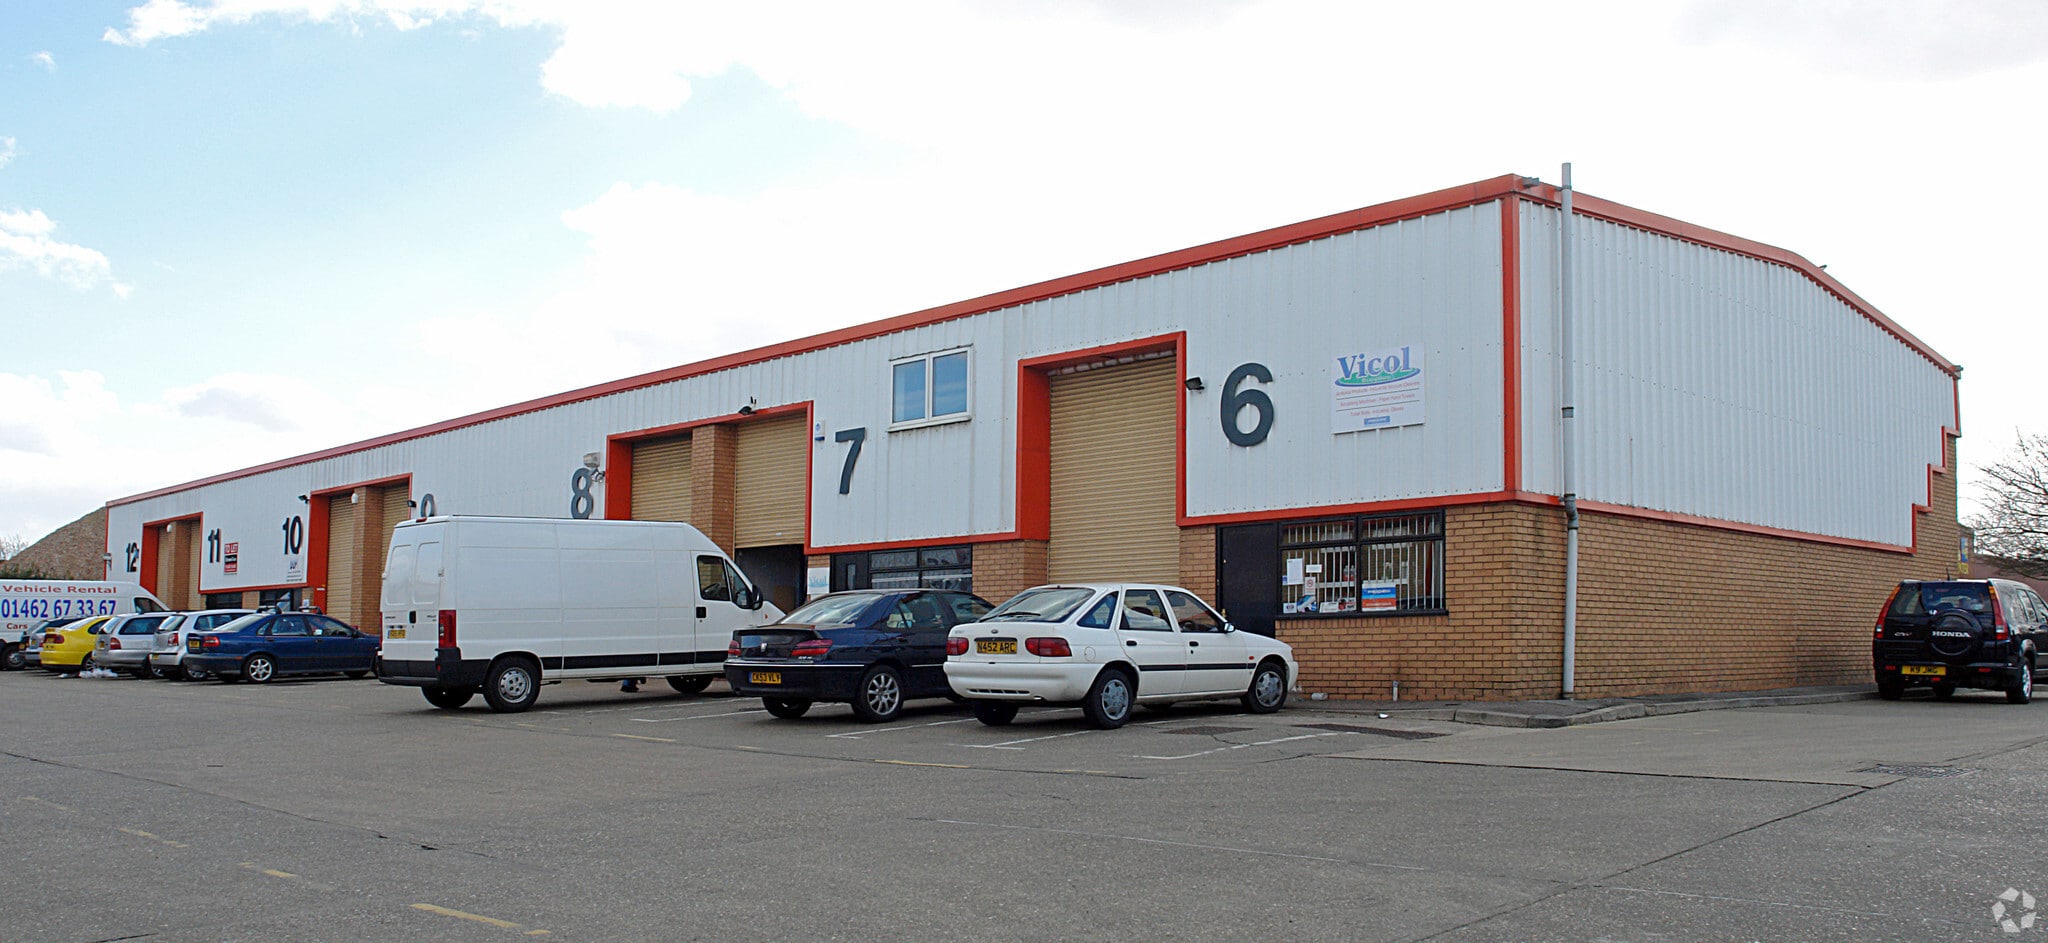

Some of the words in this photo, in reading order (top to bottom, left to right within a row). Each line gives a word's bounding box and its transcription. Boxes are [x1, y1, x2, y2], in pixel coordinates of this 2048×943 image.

[1337, 346, 1411, 378] Vicol
[1220, 362, 1275, 447] 6
[835, 427, 866, 494] 7
[571, 467, 594, 519] 8
[207, 528, 222, 563] 11
[282, 515, 304, 555] 10
[125, 542, 140, 573] 12
[2, 585, 62, 593] Vehicle
[1, 599, 48, 618] 01462
[53, 599, 71, 618] 67
[77, 599, 94, 616] 33
[98, 599, 116, 616] 67
[977, 642, 998, 652] N452
[1000, 642, 1016, 653] ARC
